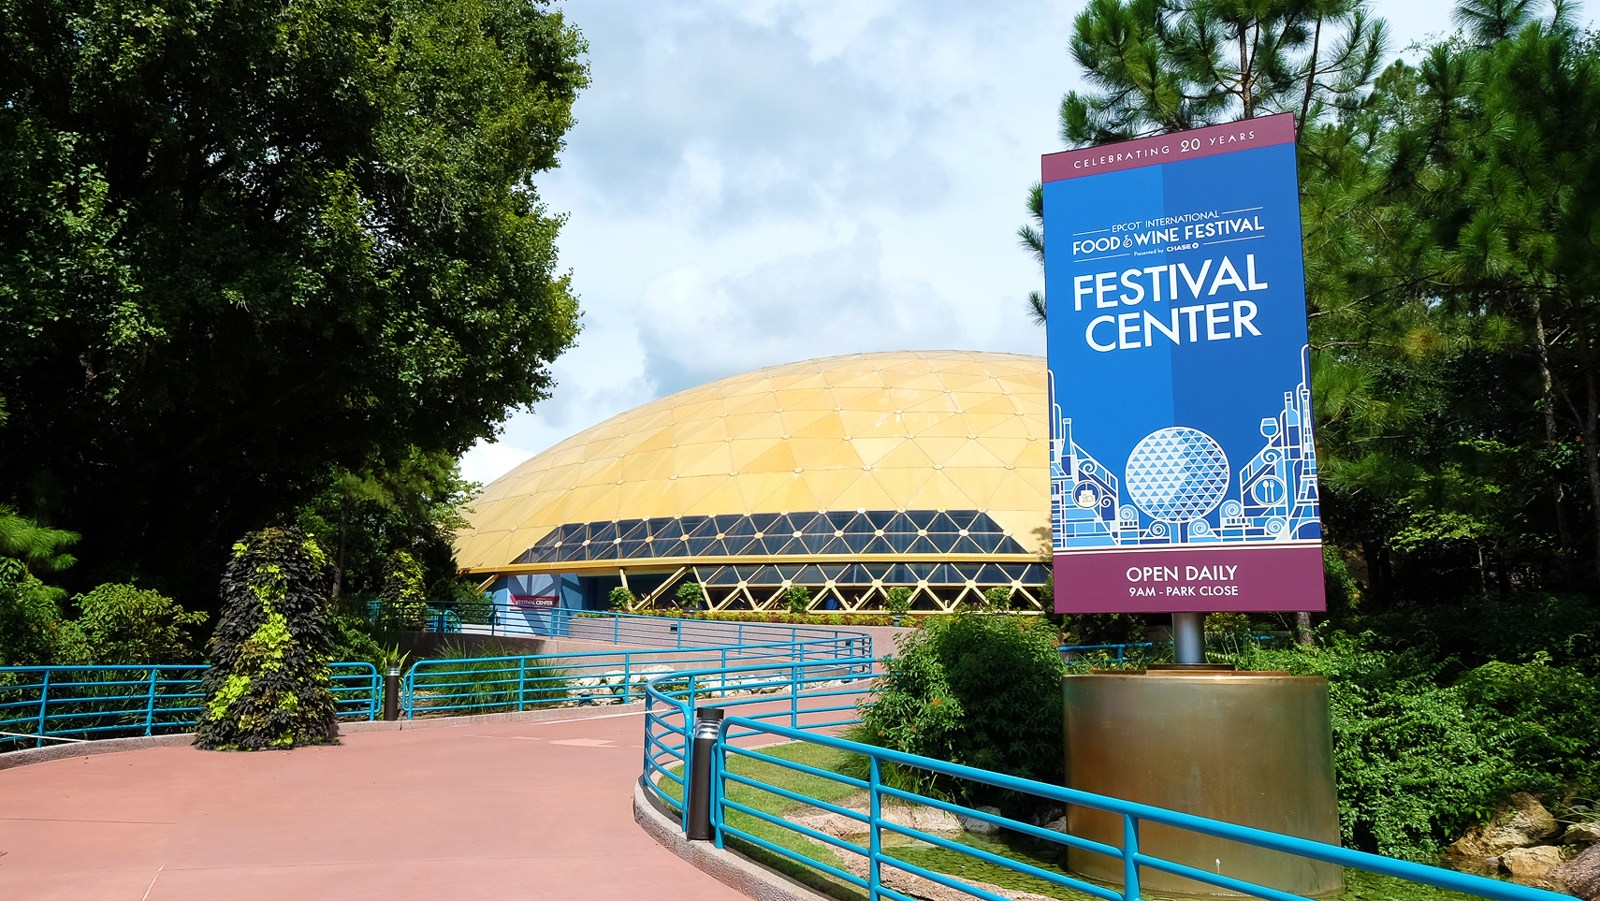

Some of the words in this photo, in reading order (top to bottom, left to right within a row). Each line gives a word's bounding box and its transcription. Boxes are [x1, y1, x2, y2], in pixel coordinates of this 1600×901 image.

[1073, 145, 1170, 169] CELEBRATING
[1180, 138, 1201, 153] 20
[1209, 130, 1256, 146] YEARS
[1072, 236, 1121, 255] FOOD
[1122, 234, 1133, 248] &
[1133, 227, 1180, 246] WINE
[1184, 215, 1265, 240] FESTIVAL
[1111, 221, 1142, 233] EPCOT
[1145, 210, 1220, 228] INTERNATIONAL
[1133, 248, 1157, 256] Presented
[1166, 243, 1191, 252] CHASE
[1073, 253, 1268, 312] FESTIVAL
[1085, 299, 1263, 353] CENTER
[1126, 565, 1179, 582] OPEN
[1185, 564, 1238, 581] DAILY
[1128, 586, 1157, 597] 9AM
[1166, 586, 1197, 597] PARK
[1199, 585, 1239, 596] CLOSE
